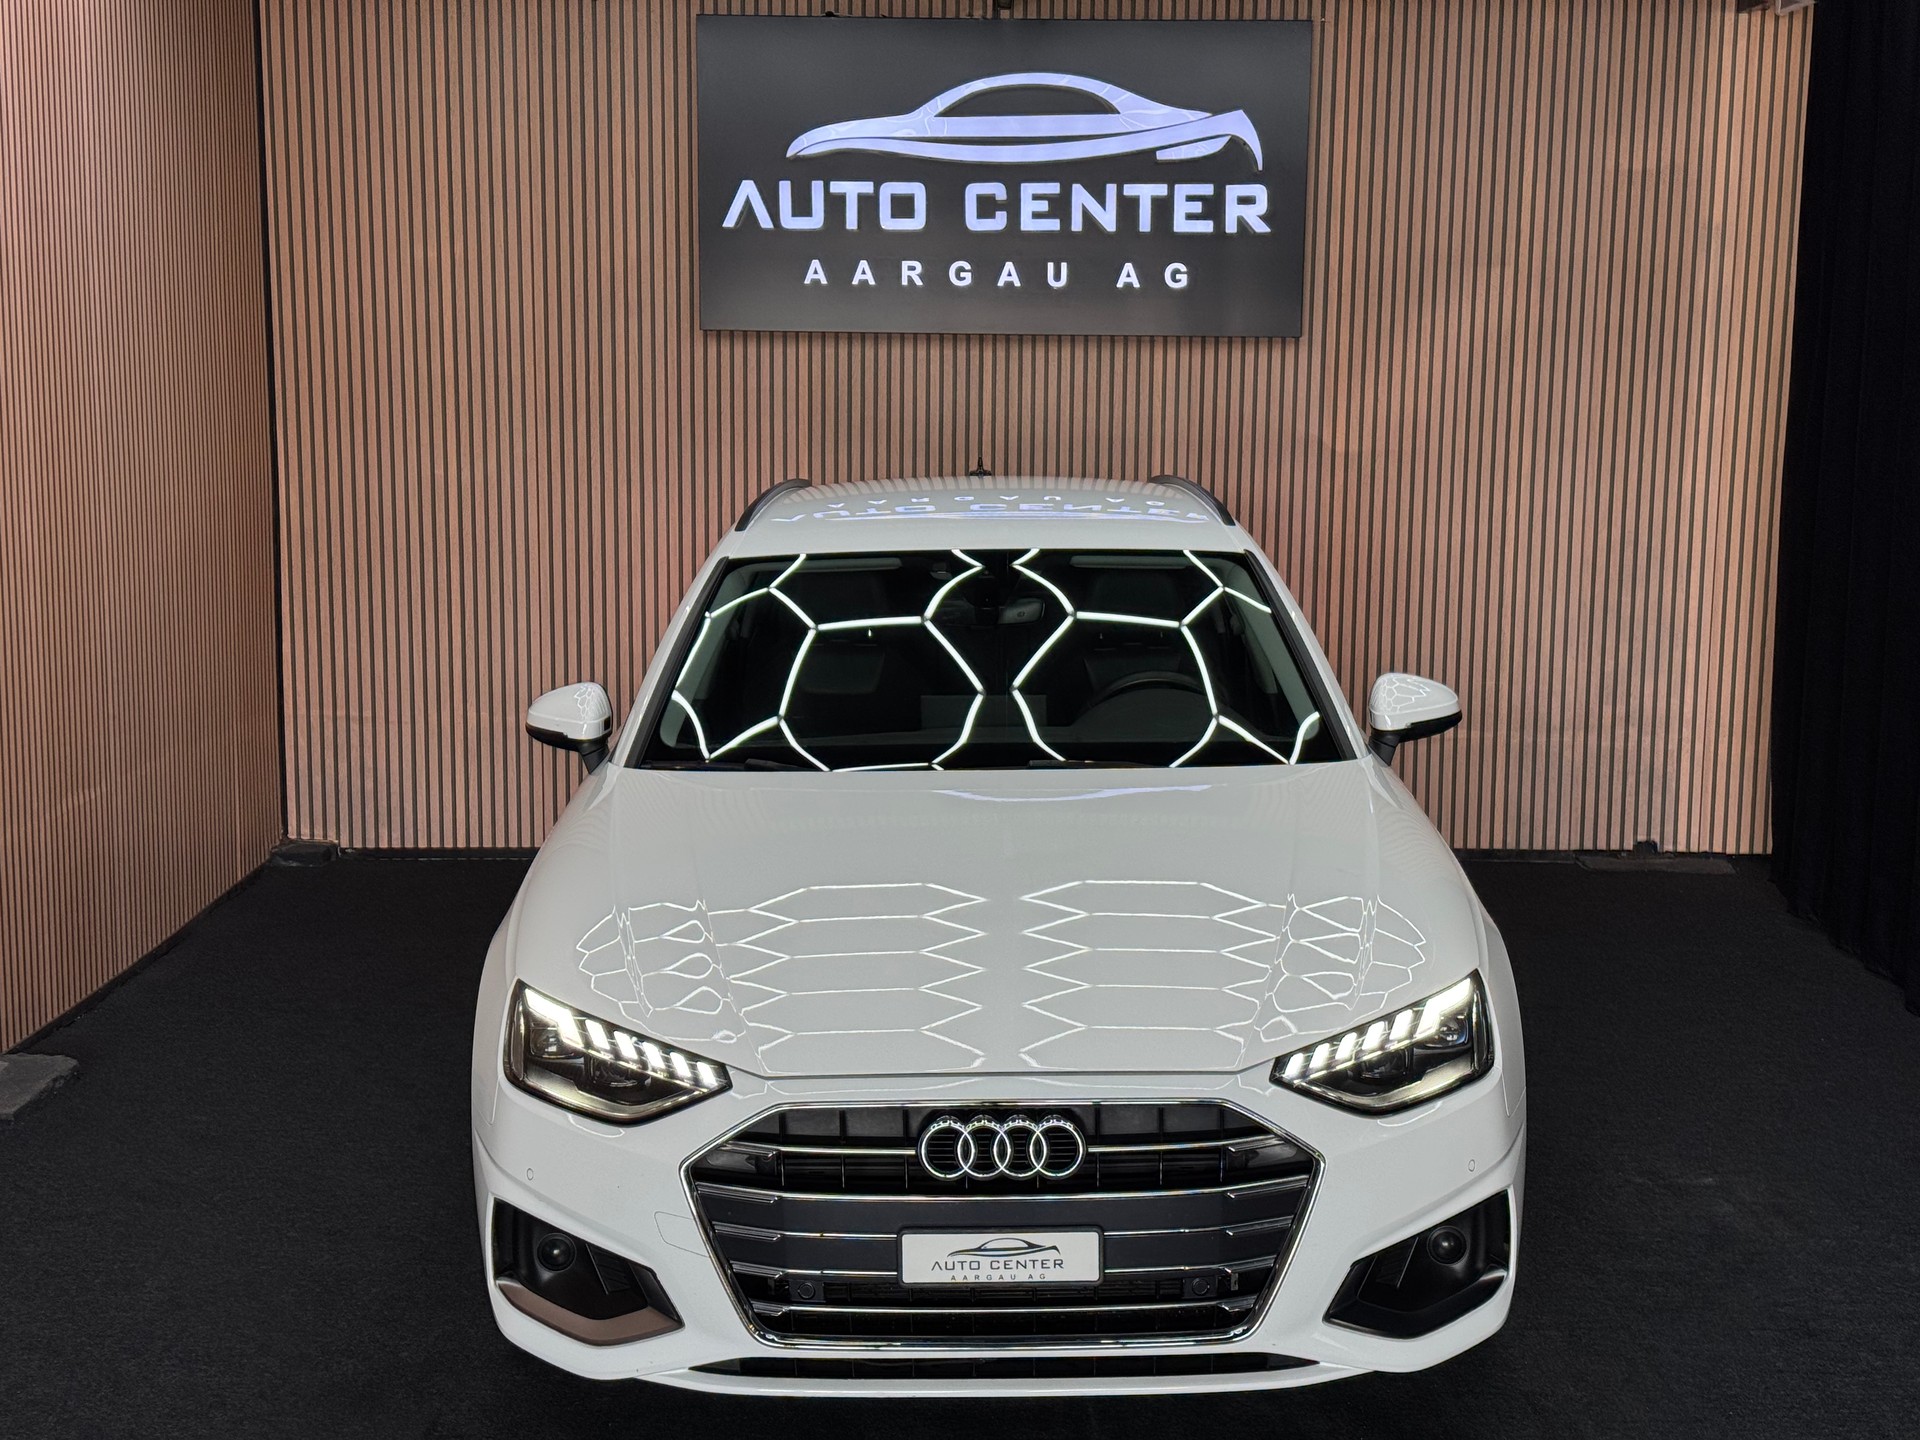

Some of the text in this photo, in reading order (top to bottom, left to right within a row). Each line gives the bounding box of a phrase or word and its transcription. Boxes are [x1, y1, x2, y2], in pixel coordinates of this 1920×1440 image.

[722, 179, 1272, 233] AUTO CENTER
[804, 259, 1188, 289] AARGAU AG
[931, 1258, 1064, 1271] AUTO CENTER
[950, 1273, 1016, 1281] AARGAU
